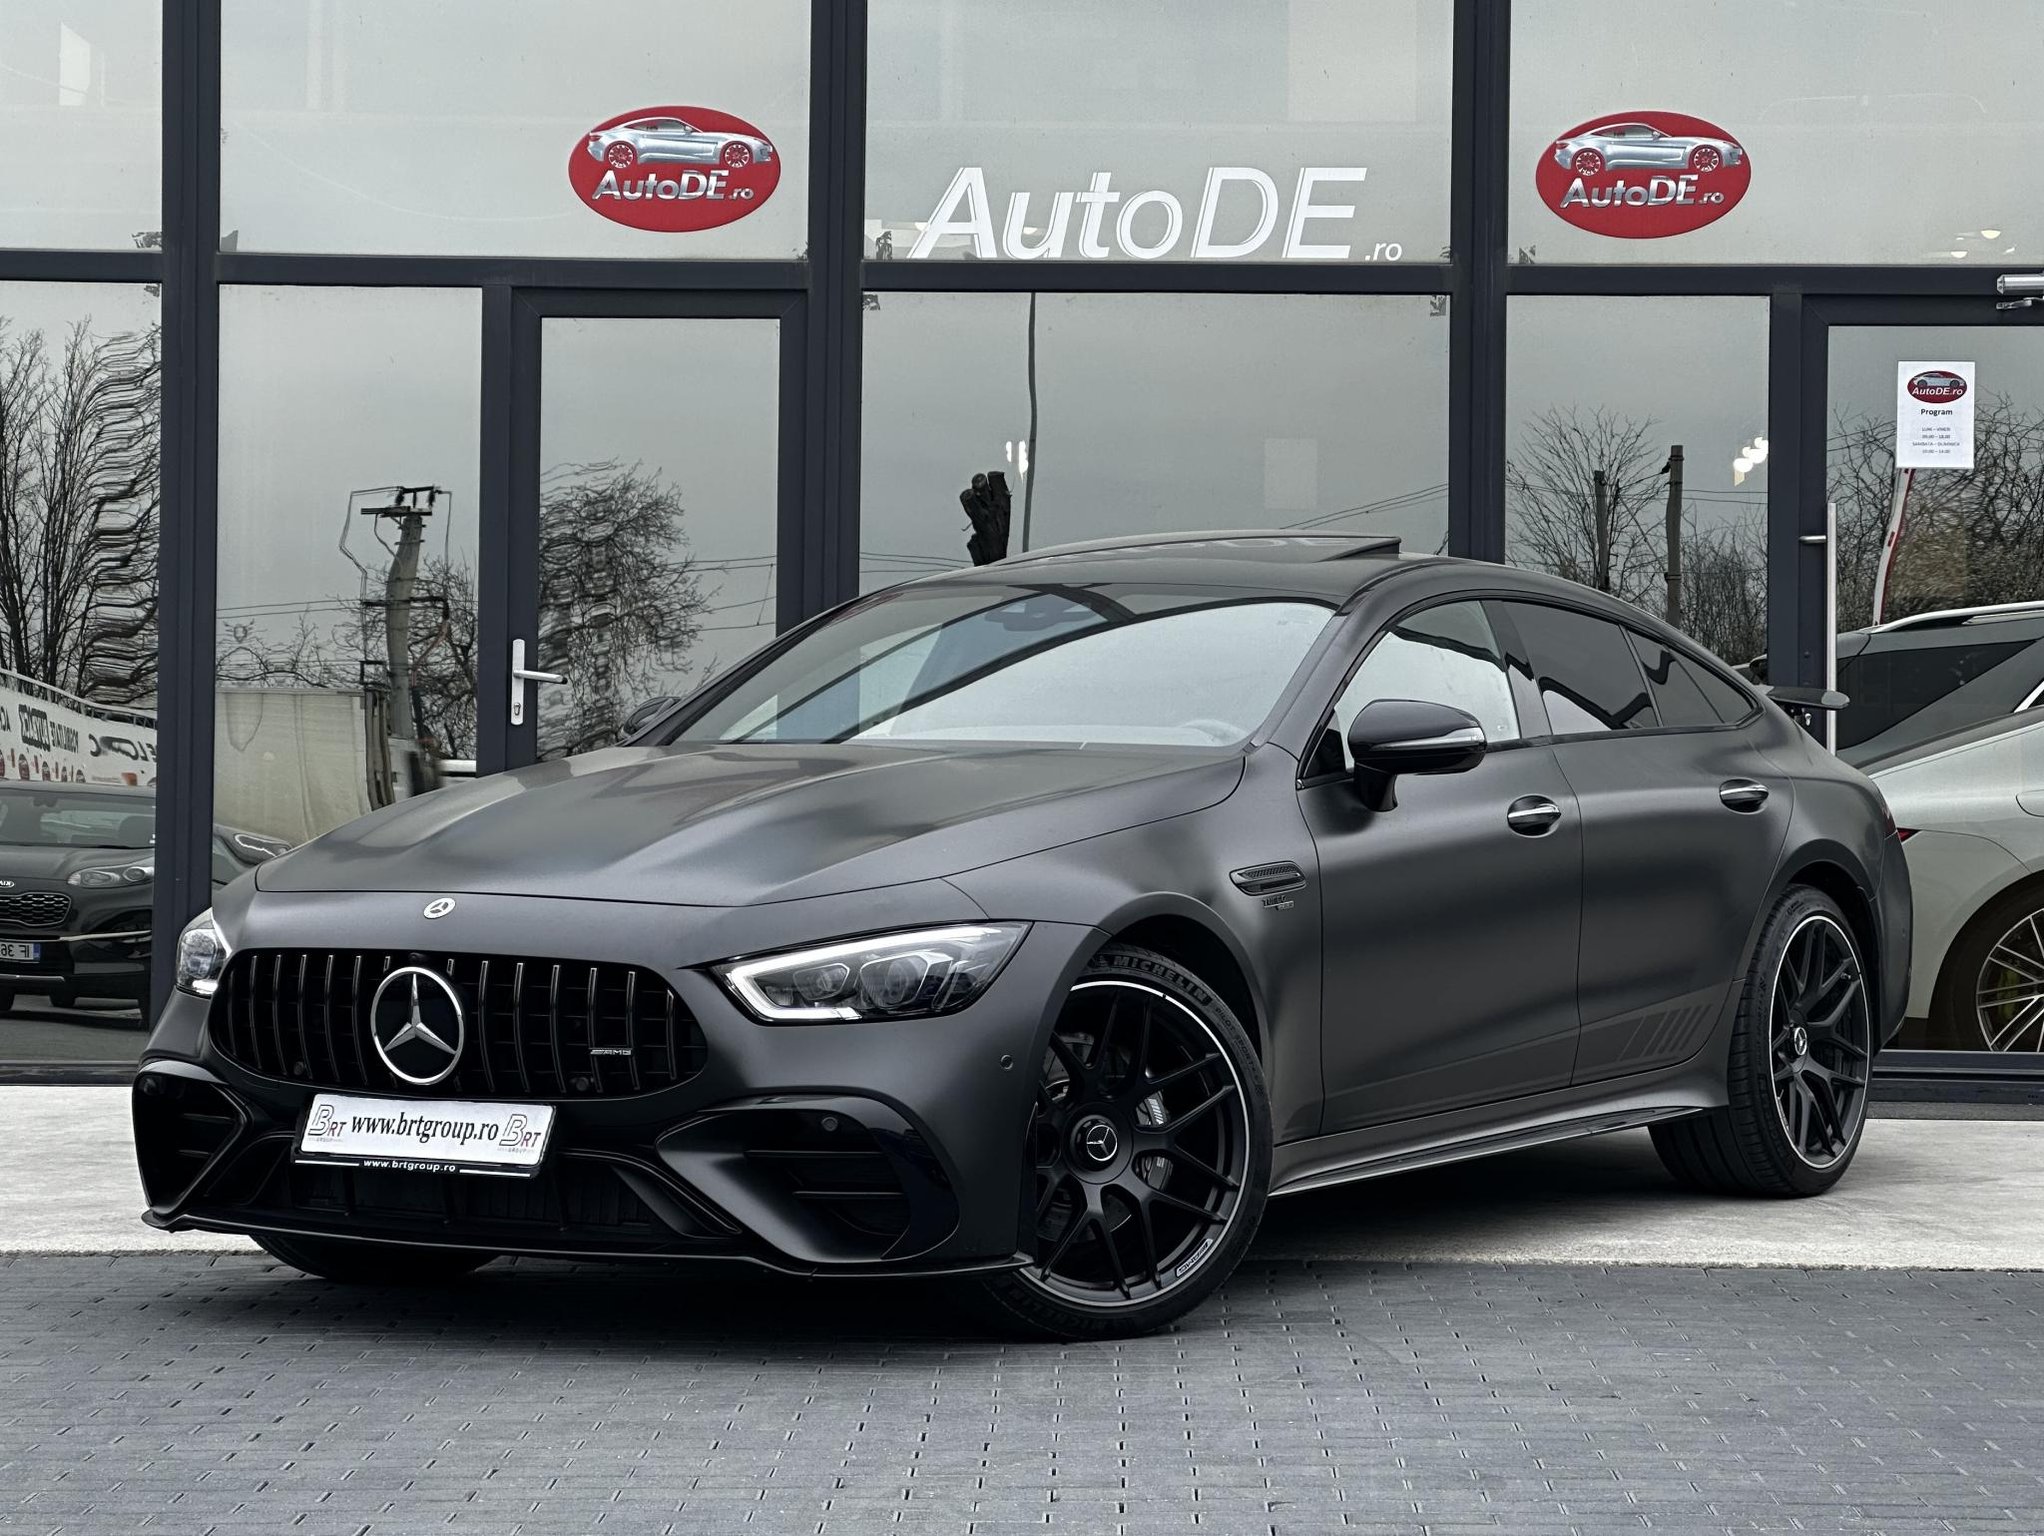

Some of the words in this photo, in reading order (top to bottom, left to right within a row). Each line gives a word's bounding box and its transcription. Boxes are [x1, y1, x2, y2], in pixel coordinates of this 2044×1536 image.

[1912, 386, 1963, 396] AutoDE.ro
[1920, 408, 1953, 417] Program
[1113, 954, 1210, 1004] MICHELIN
[351, 1111, 499, 1146] www.brtgroup.ro
[362, 1159, 456, 1173] www.brtgroup.ro
